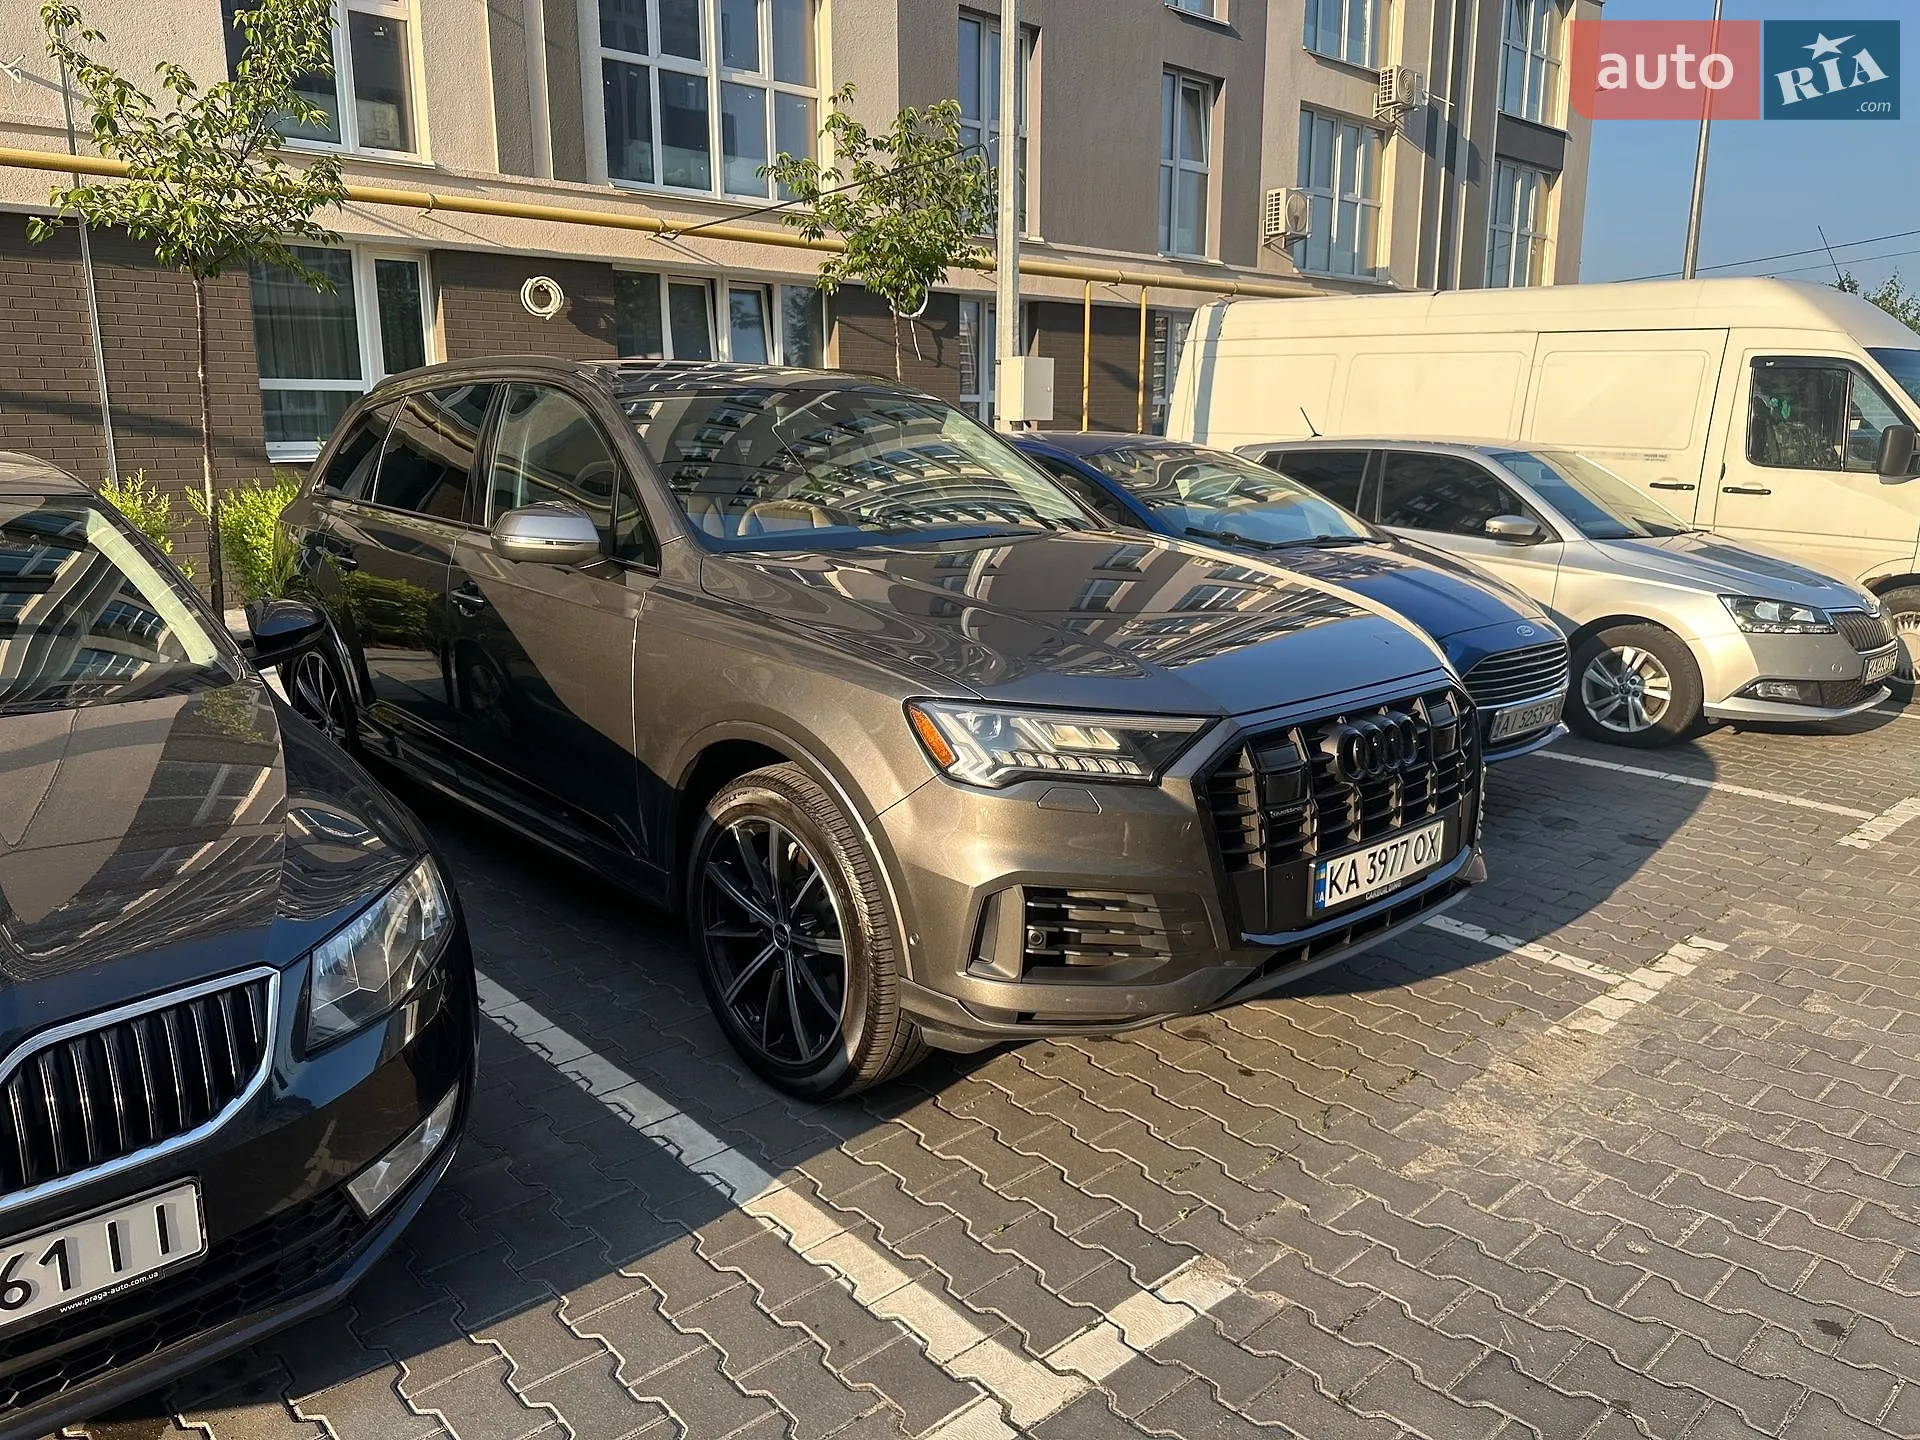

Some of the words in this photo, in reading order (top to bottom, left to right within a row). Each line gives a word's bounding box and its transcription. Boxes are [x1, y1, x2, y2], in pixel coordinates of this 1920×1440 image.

[1328, 858, 1360, 899] KA
[1366, 840, 1408, 885] 3977
[1412, 826, 1439, 865] OX
[0, 1237, 72, 1311] 61
[59, 1270, 159, 1314] www.praga-auto.com.ua
